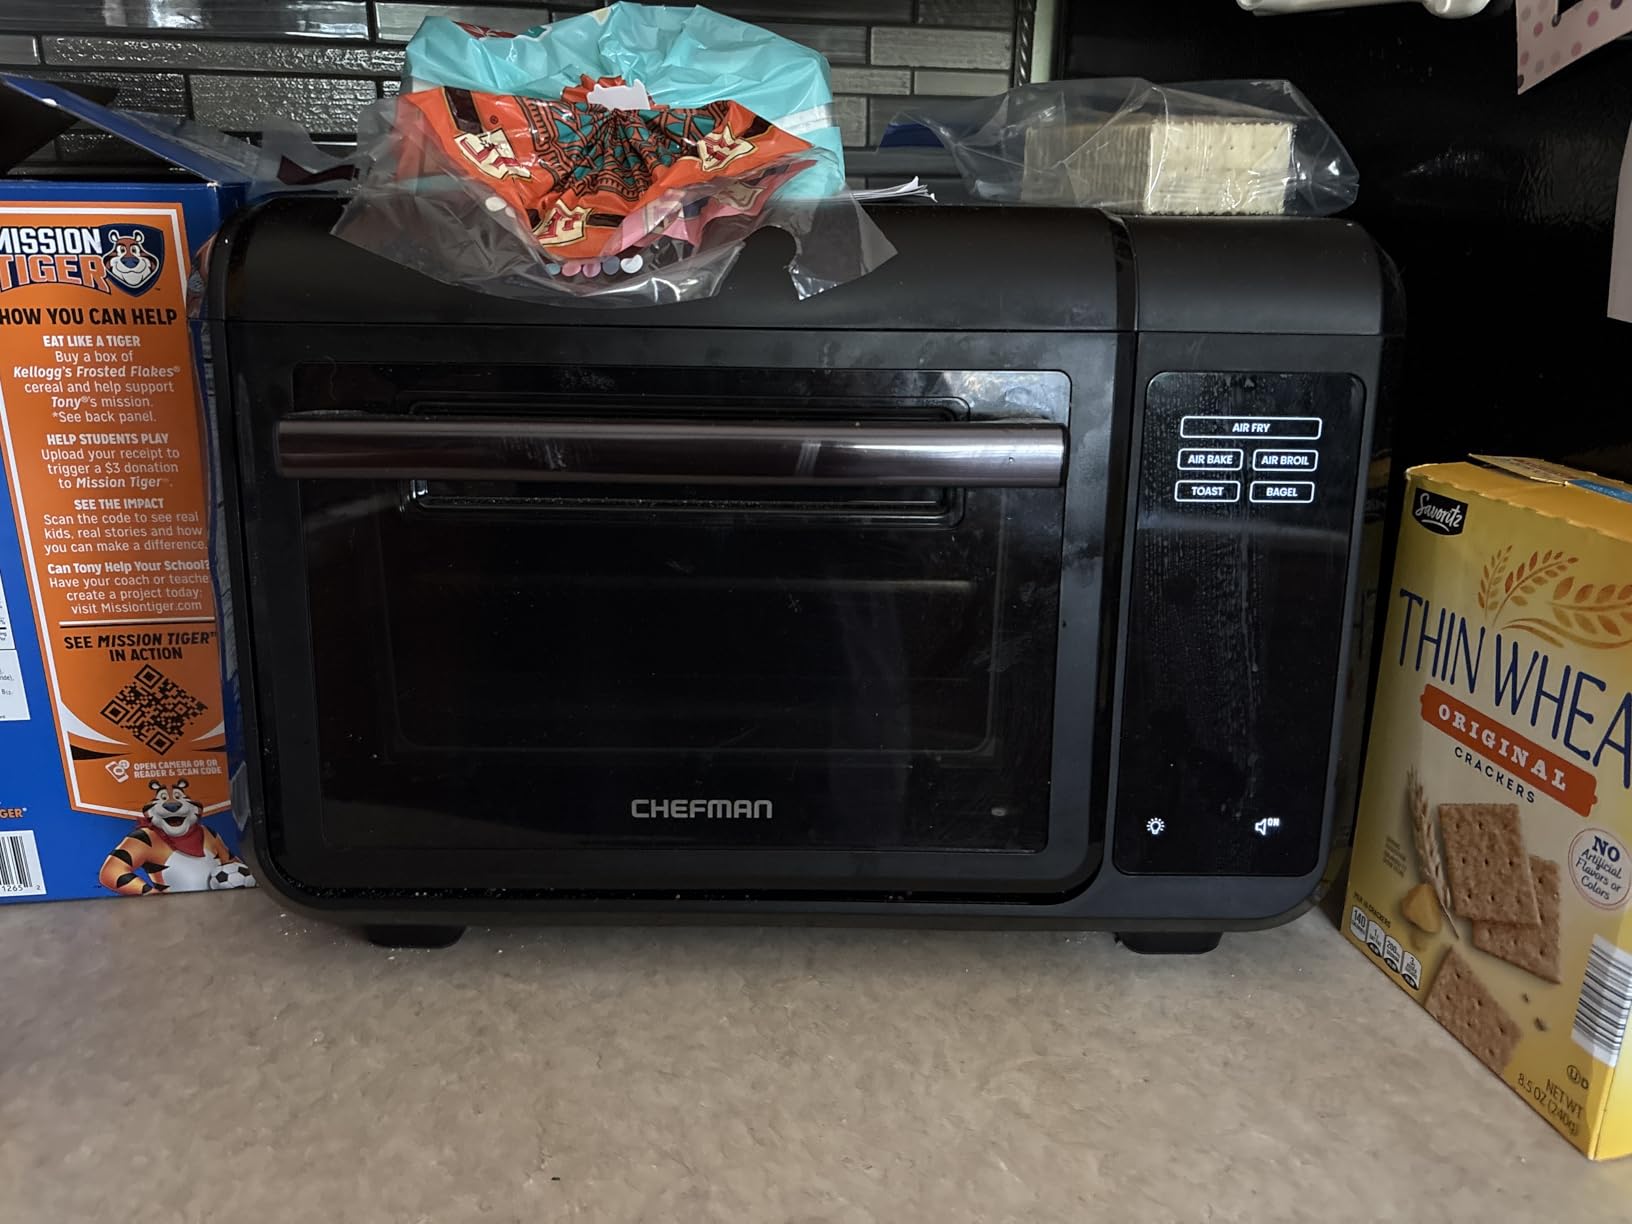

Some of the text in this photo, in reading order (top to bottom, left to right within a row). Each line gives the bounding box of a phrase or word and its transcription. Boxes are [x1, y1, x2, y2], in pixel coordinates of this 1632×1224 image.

[0, 254, 111, 293] TIGER
[0, 308, 177, 325] HOW YOU CAN HELP
[43, 335, 141, 347] EAT LIKE A TIGER
[55, 350, 134, 364] Buy a box of
[13, 366, 73, 380] Kellogg's
[76, 366, 126, 377] Frosted
[24, 381, 174, 394] cereal and help support
[101, 396, 153, 408] mission.
[85, 411, 116, 422] back
[119, 411, 157, 424] panel.
[1232, 423, 1270, 432] AIR FRY
[46, 433, 168, 445] HELP STUDENTS PLAY
[41, 448, 180, 462] Upload your receipt to
[1188, 455, 1233, 464] AIR BAKE
[1261, 456, 1309, 465] AIR BROIL
[48, 461, 179, 477] trigger a $3 donation
[58, 478, 72, 488] to
[76, 477, 126, 488] Mission
[1192, 487, 1224, 496] TOAST
[1266, 487, 1298, 497] BAGEL
[74, 498, 164, 510] SEE THE IMPACT
[1415, 492, 1463, 528] Savoritz
[43, 512, 199, 525] Scan the code to see real
[44, 526, 203, 540] kids, real stories and how
[44, 540, 208, 555] you can make a difference.
[47, 564, 71, 574] Can
[73, 563, 102, 575] Tony
[104, 562, 132, 574] Help
[134, 561, 162, 571] Your
[49, 574, 210, 589] Have your coach or teache
[66, 590, 105, 601] create
[109, 591, 116, 600] a
[120, 588, 161, 601] project
[71, 601, 202, 614] visit Missiontiger.com
[64, 636, 93, 649] SEE
[97, 633, 162, 648] MISSION
[1399, 588, 1486, 694] THIN
[109, 647, 183, 661] IN ACTION
[1438, 704, 1567, 791] ORIGINAL
[134, 762, 157, 771] OPEN
[158, 761, 192, 770] CAMERA
[193, 760, 205, 768] OR
[134, 770, 167, 778] READER
[176, 768, 199, 776] SCAN
[200, 766, 222, 775] CODE
[1454, 746, 1535, 803] CRACKERS
[631, 799, 773, 818] CHEFMAN
[1267, 817, 1280, 826] ON
[1592, 835, 1620, 862] NO
[1581, 848, 1621, 879] Artificial
[1576, 857, 1621, 892] Flavors or
[1581, 875, 1610, 900] Colors
[1518, 1073, 1578, 1136] 8.5 OZ (240g)
[1546, 1079, 1583, 1118] NET WT
